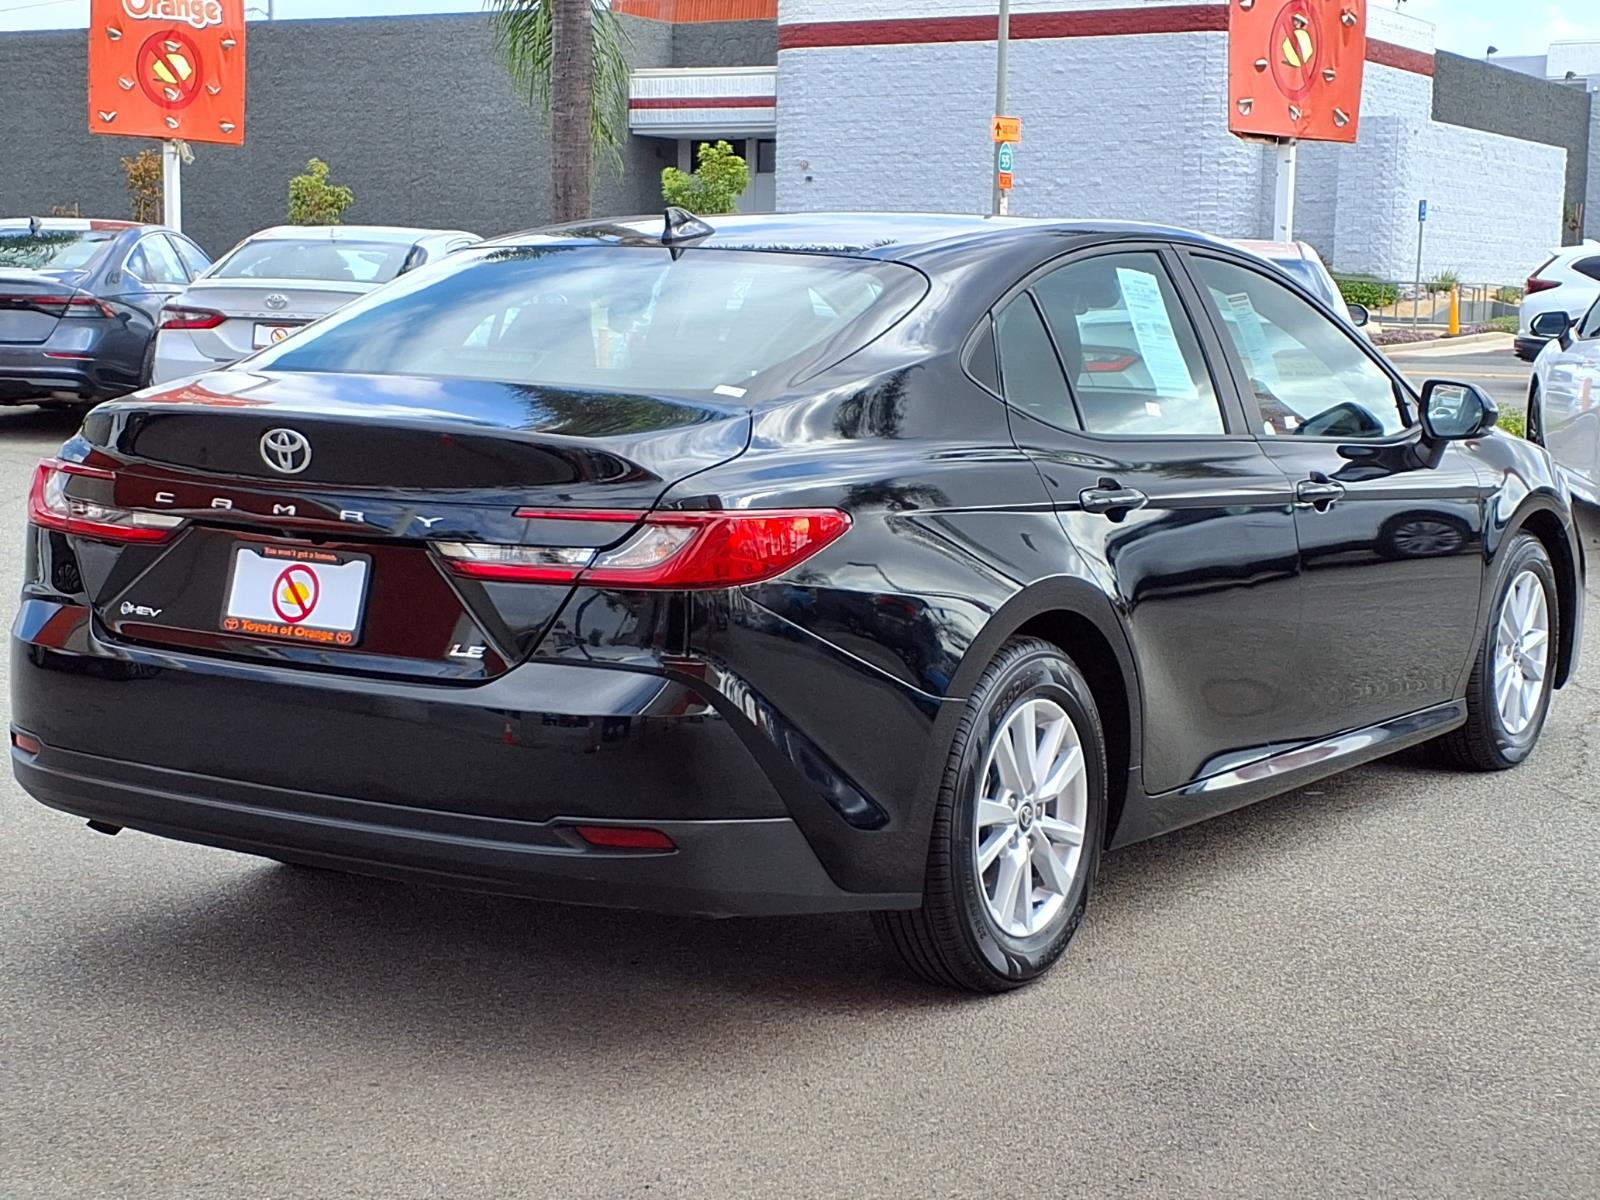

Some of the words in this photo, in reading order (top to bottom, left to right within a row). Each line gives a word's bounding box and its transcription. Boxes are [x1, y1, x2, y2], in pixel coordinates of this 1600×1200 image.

[122, 0, 222, 28] Orange
[155, 491, 443, 528] CAMRY
[241, 620, 278, 634] Toyota
[279, 625, 293, 636] of
[294, 626, 335, 641] Orange
[449, 644, 487, 659] LE
